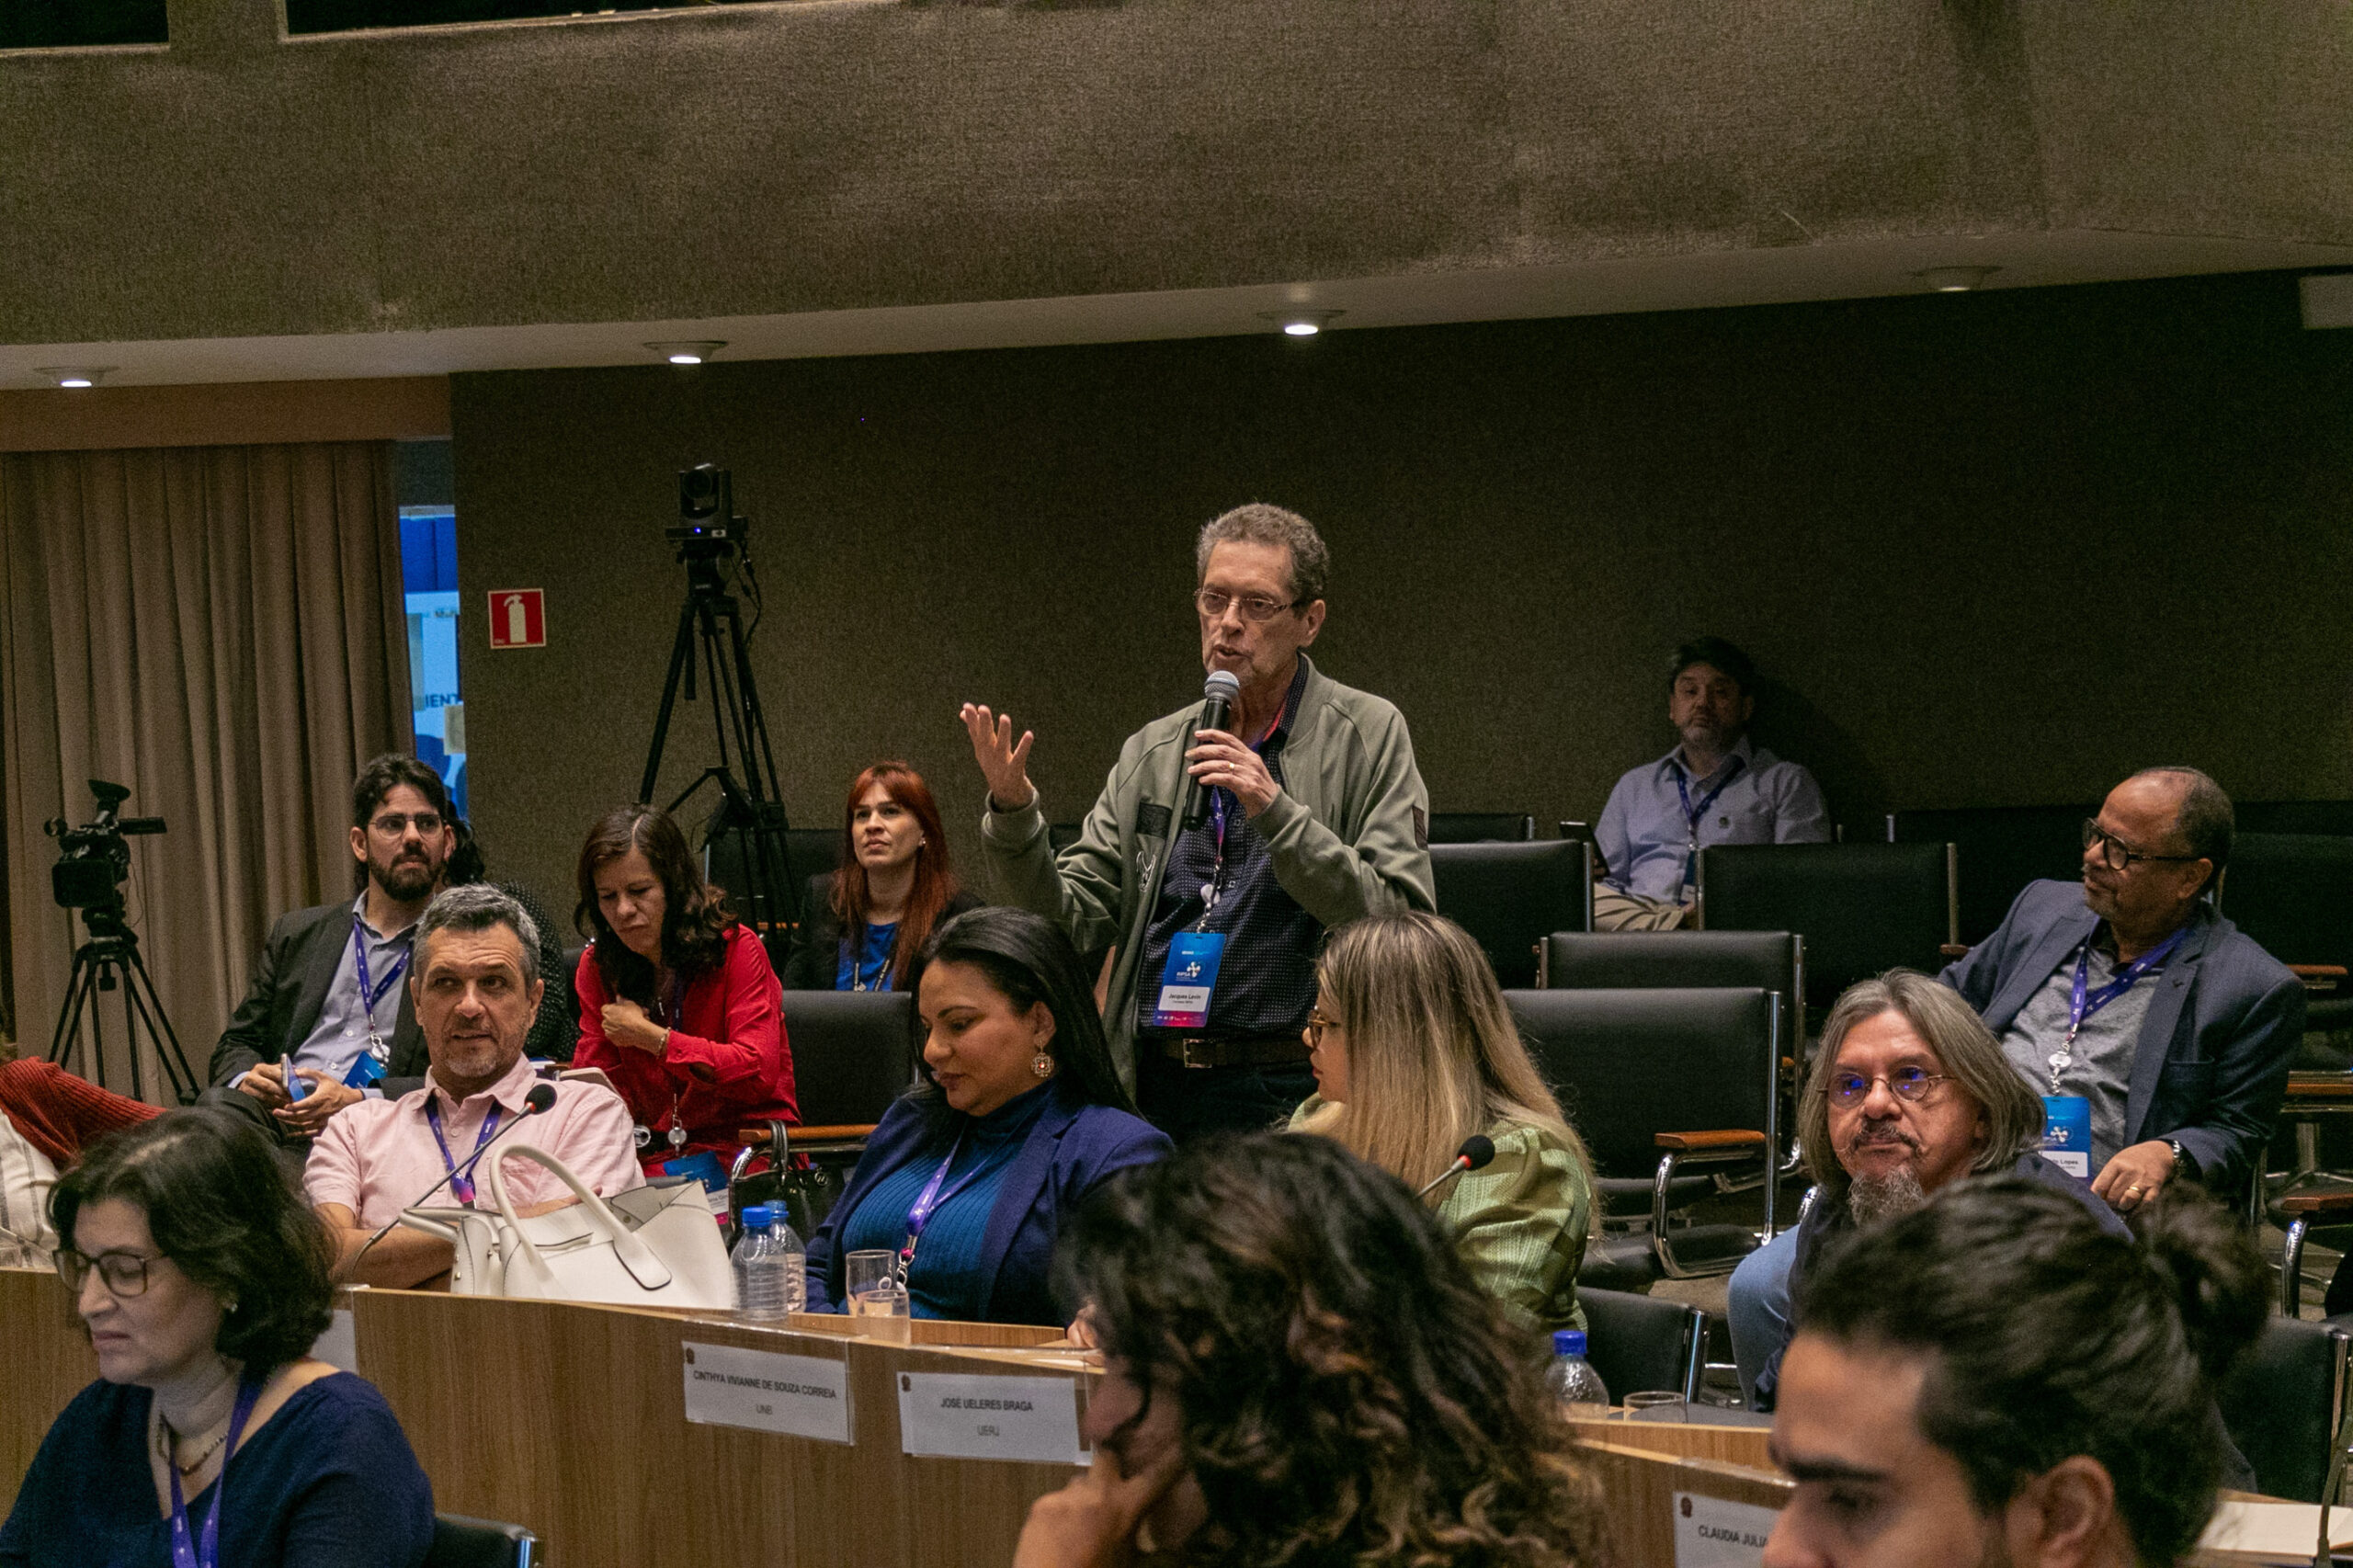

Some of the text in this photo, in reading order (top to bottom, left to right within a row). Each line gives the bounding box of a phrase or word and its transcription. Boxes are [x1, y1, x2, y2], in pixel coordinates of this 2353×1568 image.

[693, 1369, 725, 1384] CINTHYA
[762, 1380, 773, 1391] DE
[774, 1381, 801, 1393] SOUZA
[801, 1385, 836, 1399] CORREIA
[963, 1398, 1002, 1411] UELERES
[1003, 1400, 1033, 1412] BRAGA
[976, 1425, 1000, 1437] UERJ
[1698, 1525, 1739, 1542] CLAUDIA
